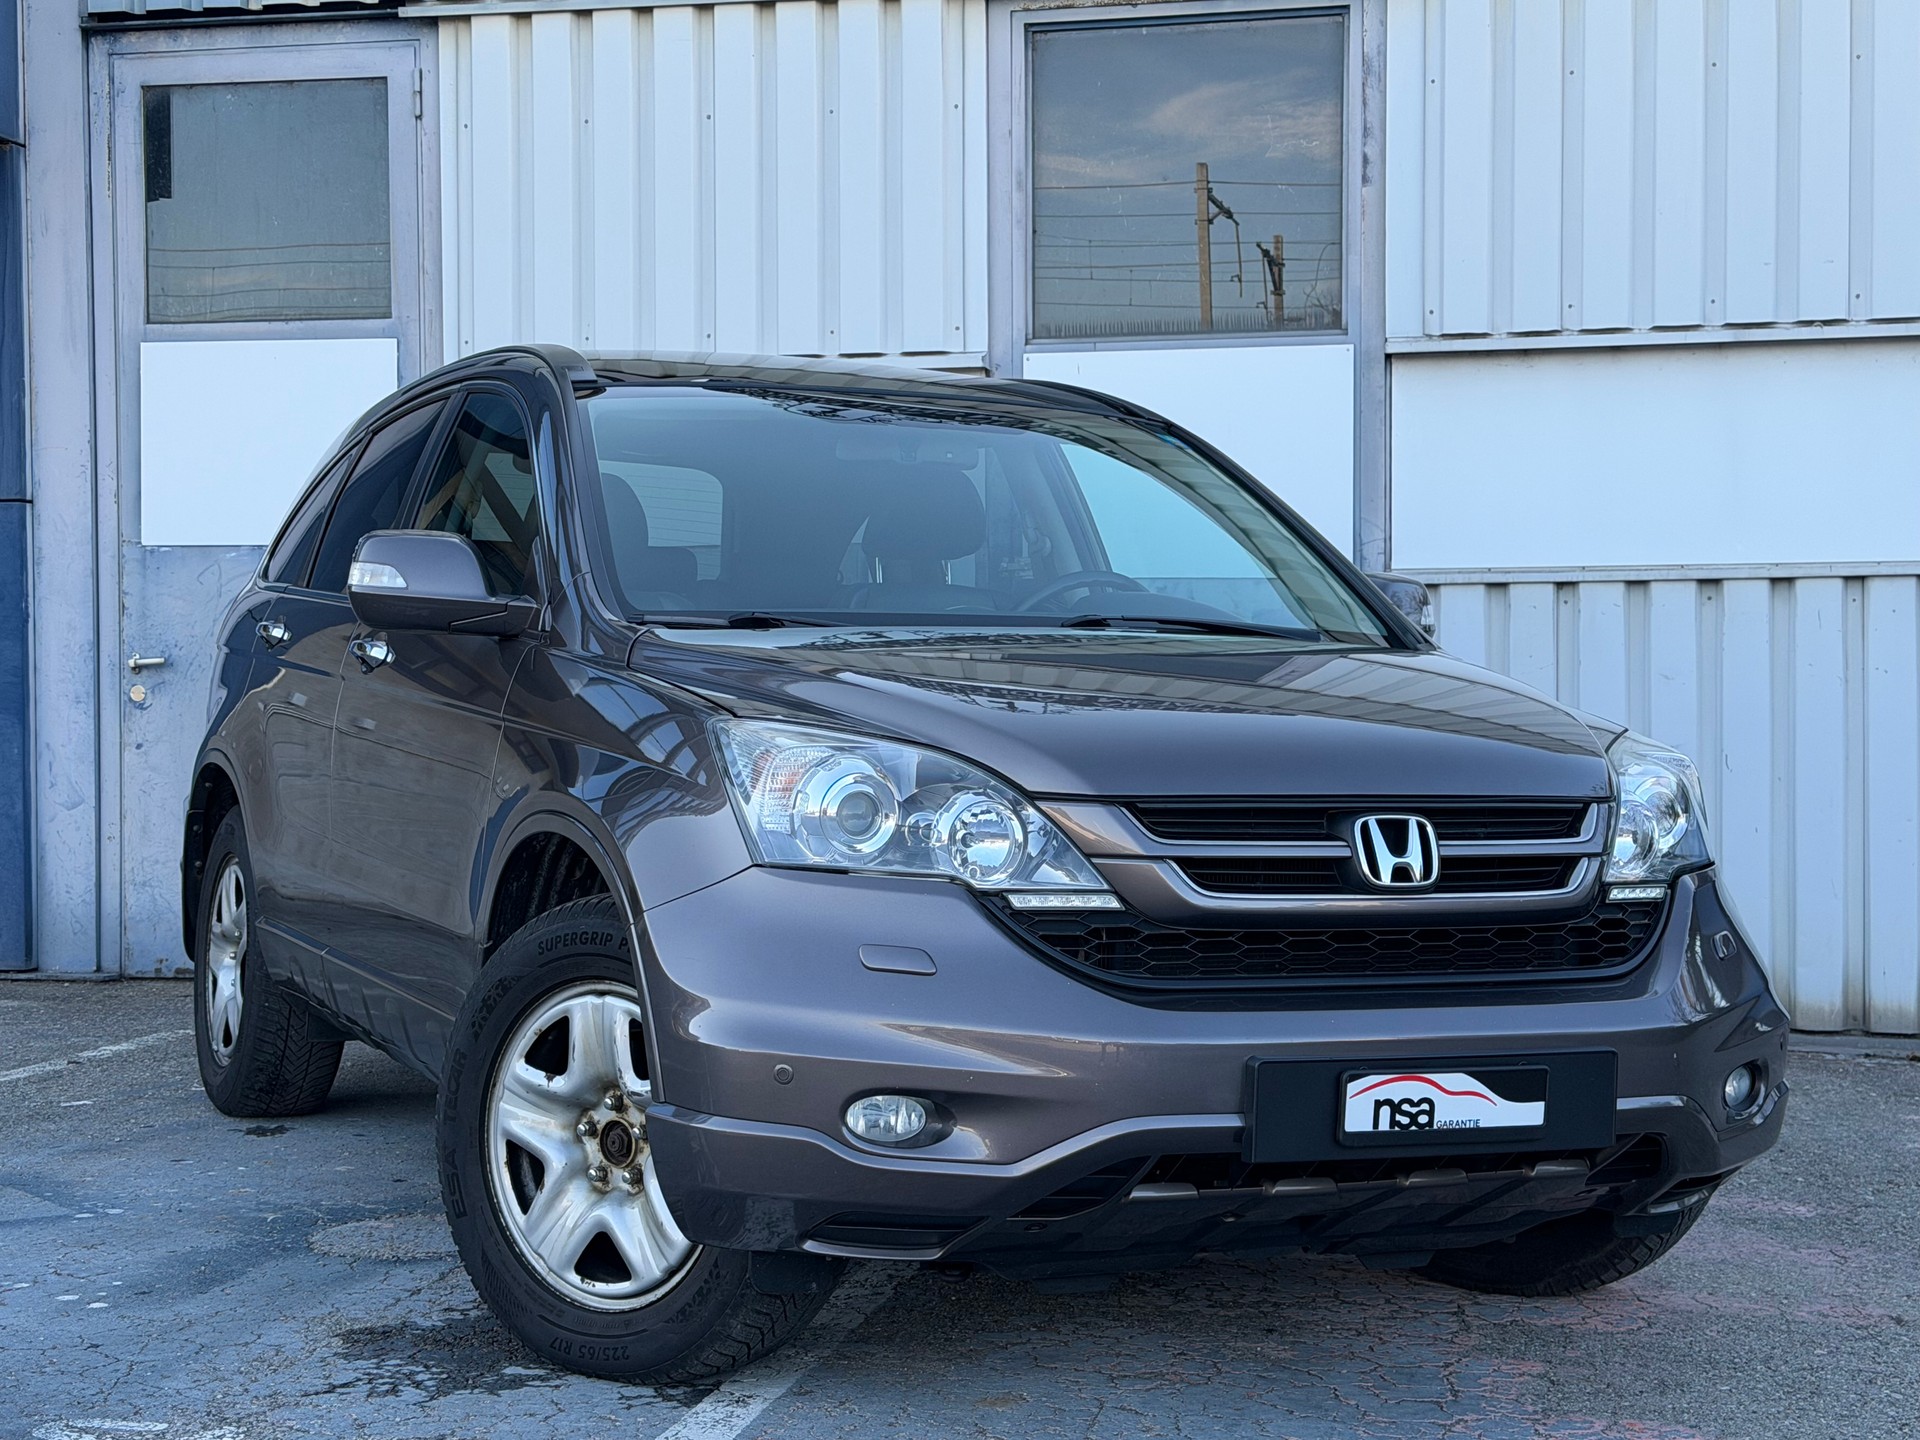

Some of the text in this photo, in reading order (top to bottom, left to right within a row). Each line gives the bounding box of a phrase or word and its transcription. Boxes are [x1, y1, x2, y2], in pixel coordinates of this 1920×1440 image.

[537, 930, 631, 956] SUPERGRIP P
[1372, 1097, 1481, 1131] nsa GARANTIE
[549, 1336, 630, 1361] 225/65 R17
